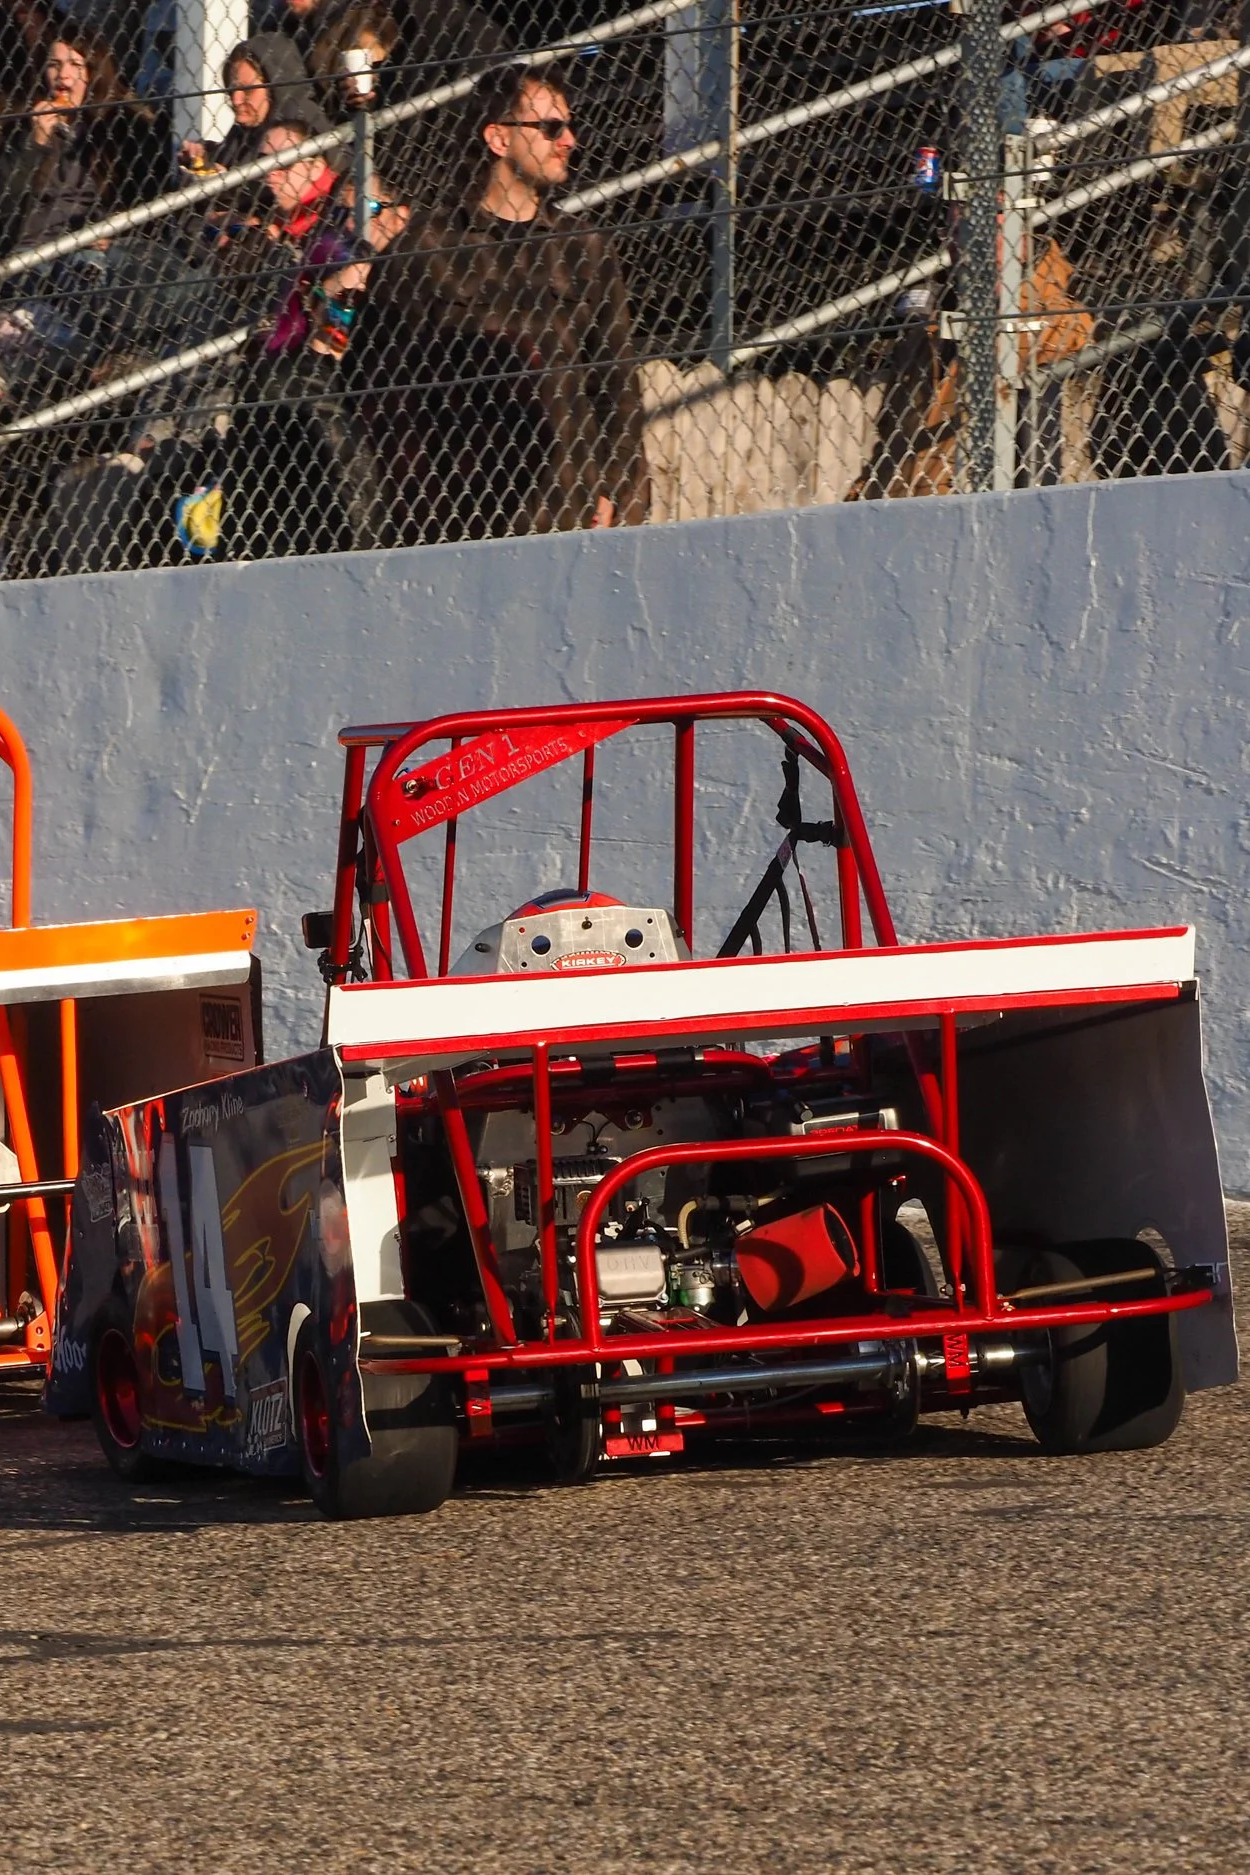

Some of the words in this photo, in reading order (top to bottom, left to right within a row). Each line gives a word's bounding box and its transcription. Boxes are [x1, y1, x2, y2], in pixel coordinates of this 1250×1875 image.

[435, 741, 498, 791] GEN
[501, 733, 520, 756] 1
[469, 737, 569, 796] MOTORSPORTS
[561, 955, 615, 967] KIRKEY
[221, 1093, 244, 1120] Kline
[250, 1391, 284, 1437] KLOTZ
[627, 1434, 660, 1451] WM
